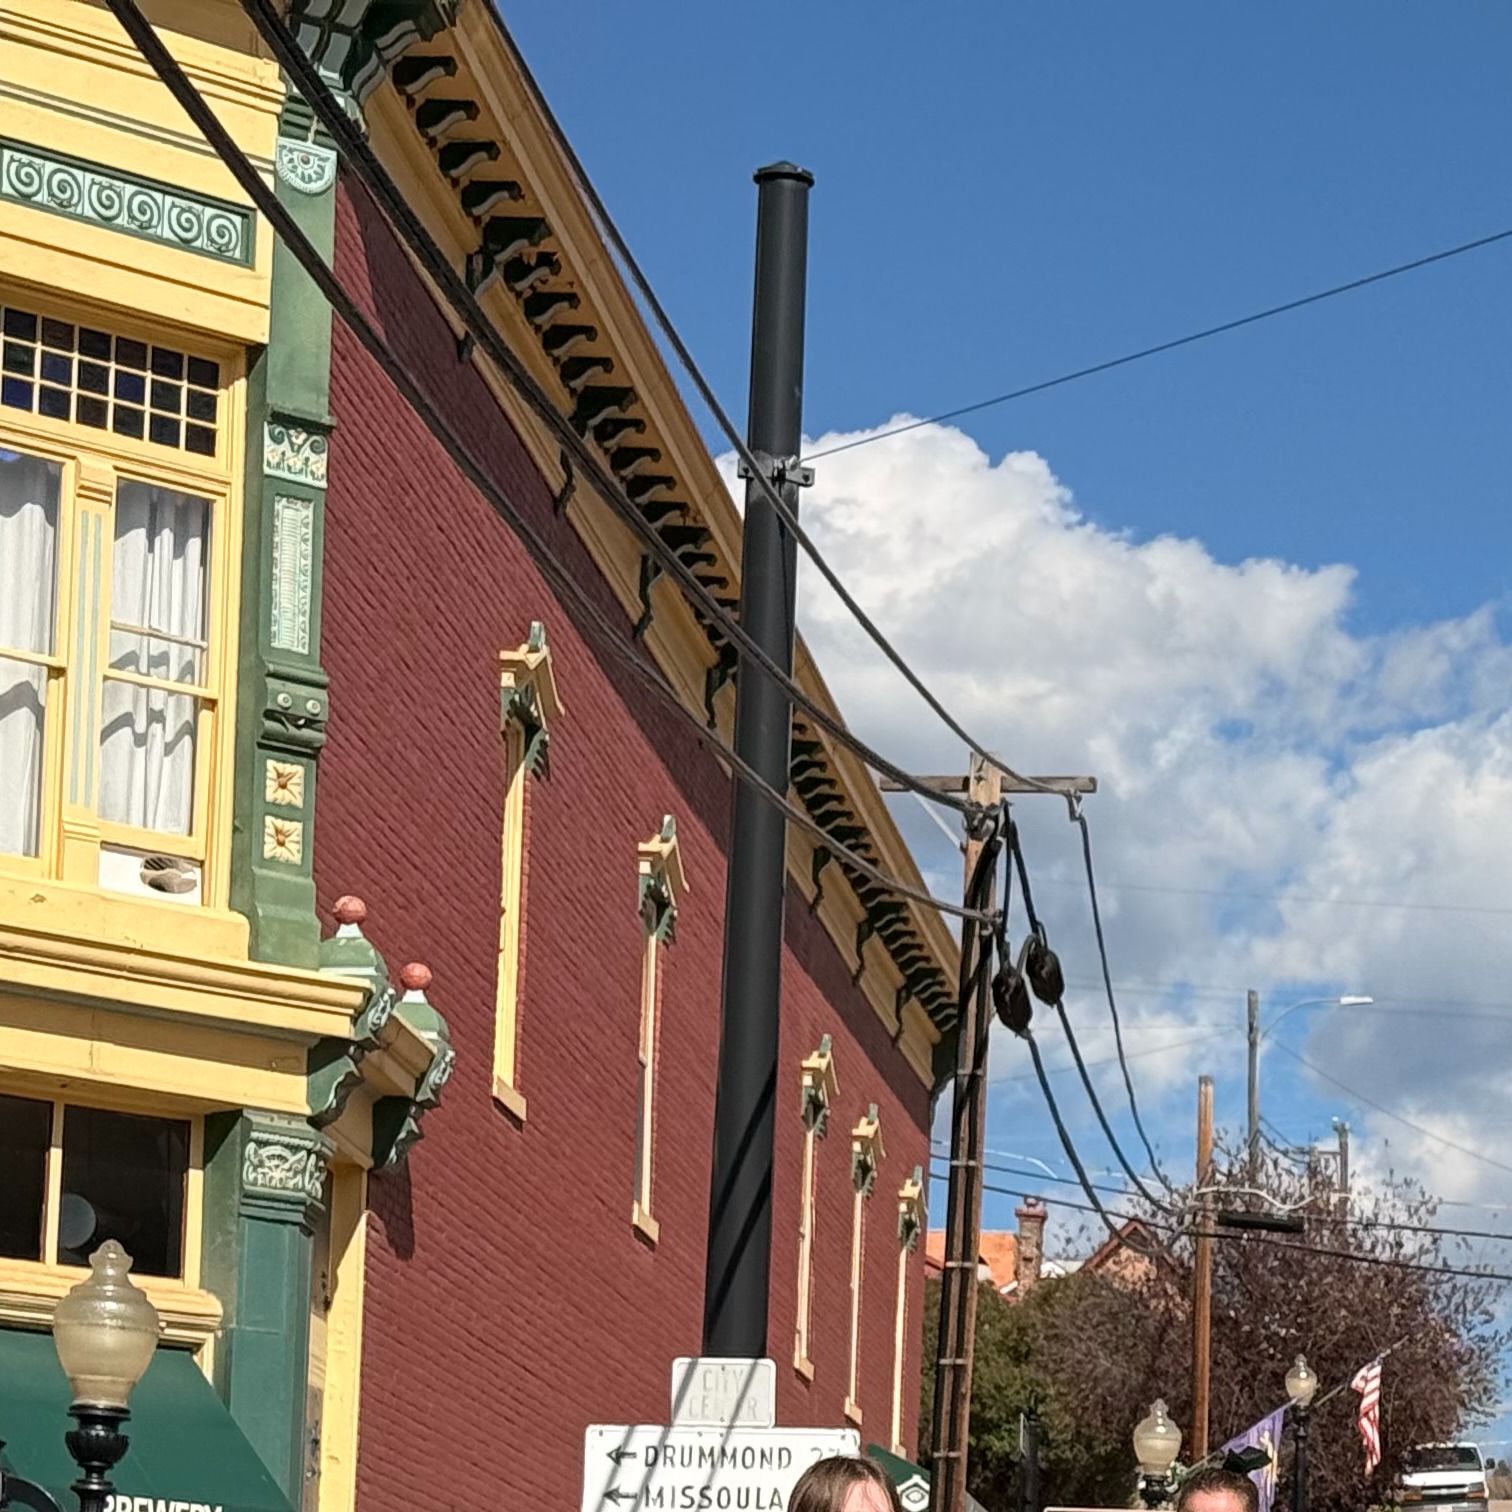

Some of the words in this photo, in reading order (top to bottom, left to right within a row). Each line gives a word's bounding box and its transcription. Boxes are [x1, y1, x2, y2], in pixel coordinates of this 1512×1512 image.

[688, 1395, 758, 1420] CER
[644, 1445, 793, 1469] DRUMMOND
[644, 1485, 784, 1510] MISSOULA
